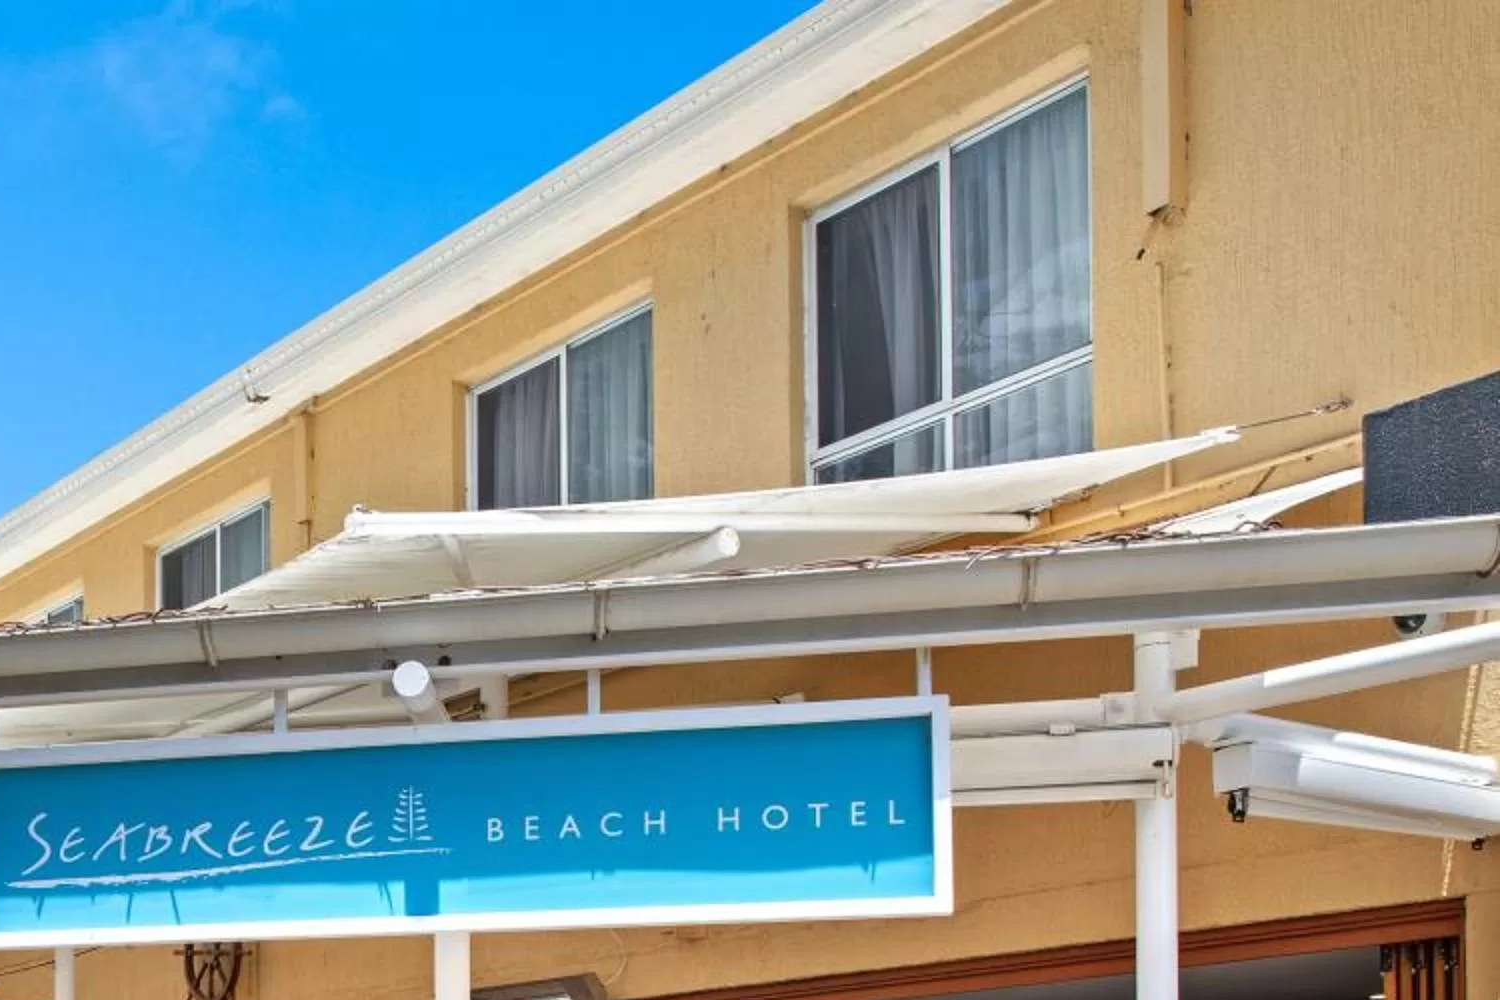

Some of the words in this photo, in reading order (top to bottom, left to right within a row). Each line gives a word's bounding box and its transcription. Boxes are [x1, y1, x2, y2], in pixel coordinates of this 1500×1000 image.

[21, 811, 374, 876] SEABREEZE
[486, 809, 667, 842] BEACH
[716, 799, 906, 833] HOTEL
